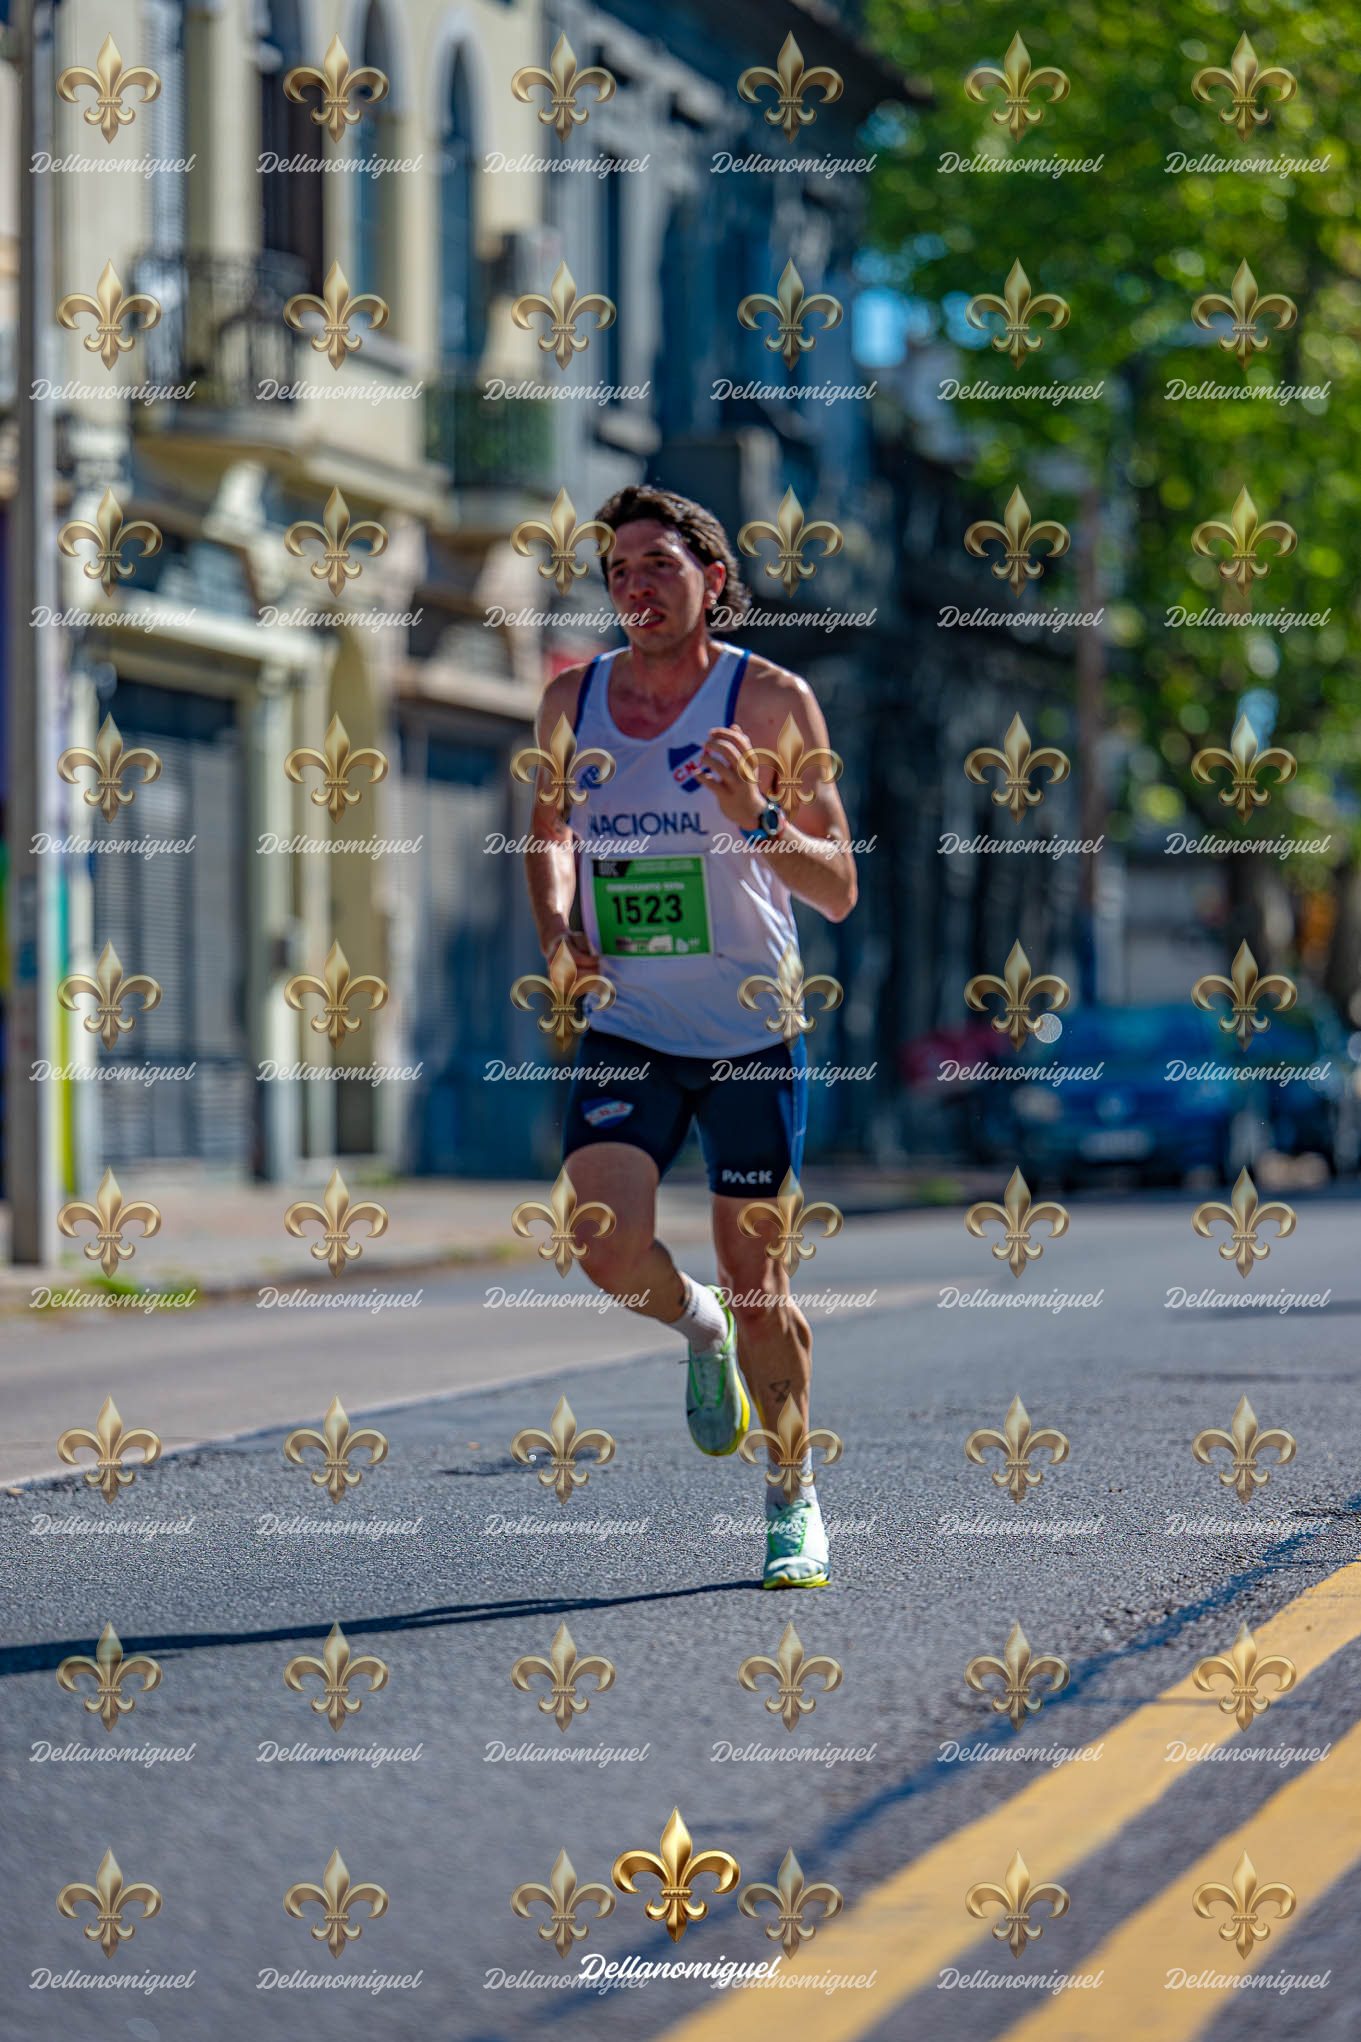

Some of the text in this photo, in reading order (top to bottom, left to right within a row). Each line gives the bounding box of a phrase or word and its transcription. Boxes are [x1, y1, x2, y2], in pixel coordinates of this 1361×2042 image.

[590, 812, 709, 837] NACIONAL
[613, 895, 683, 924] 1523
[722, 1169, 773, 1185] PACK
